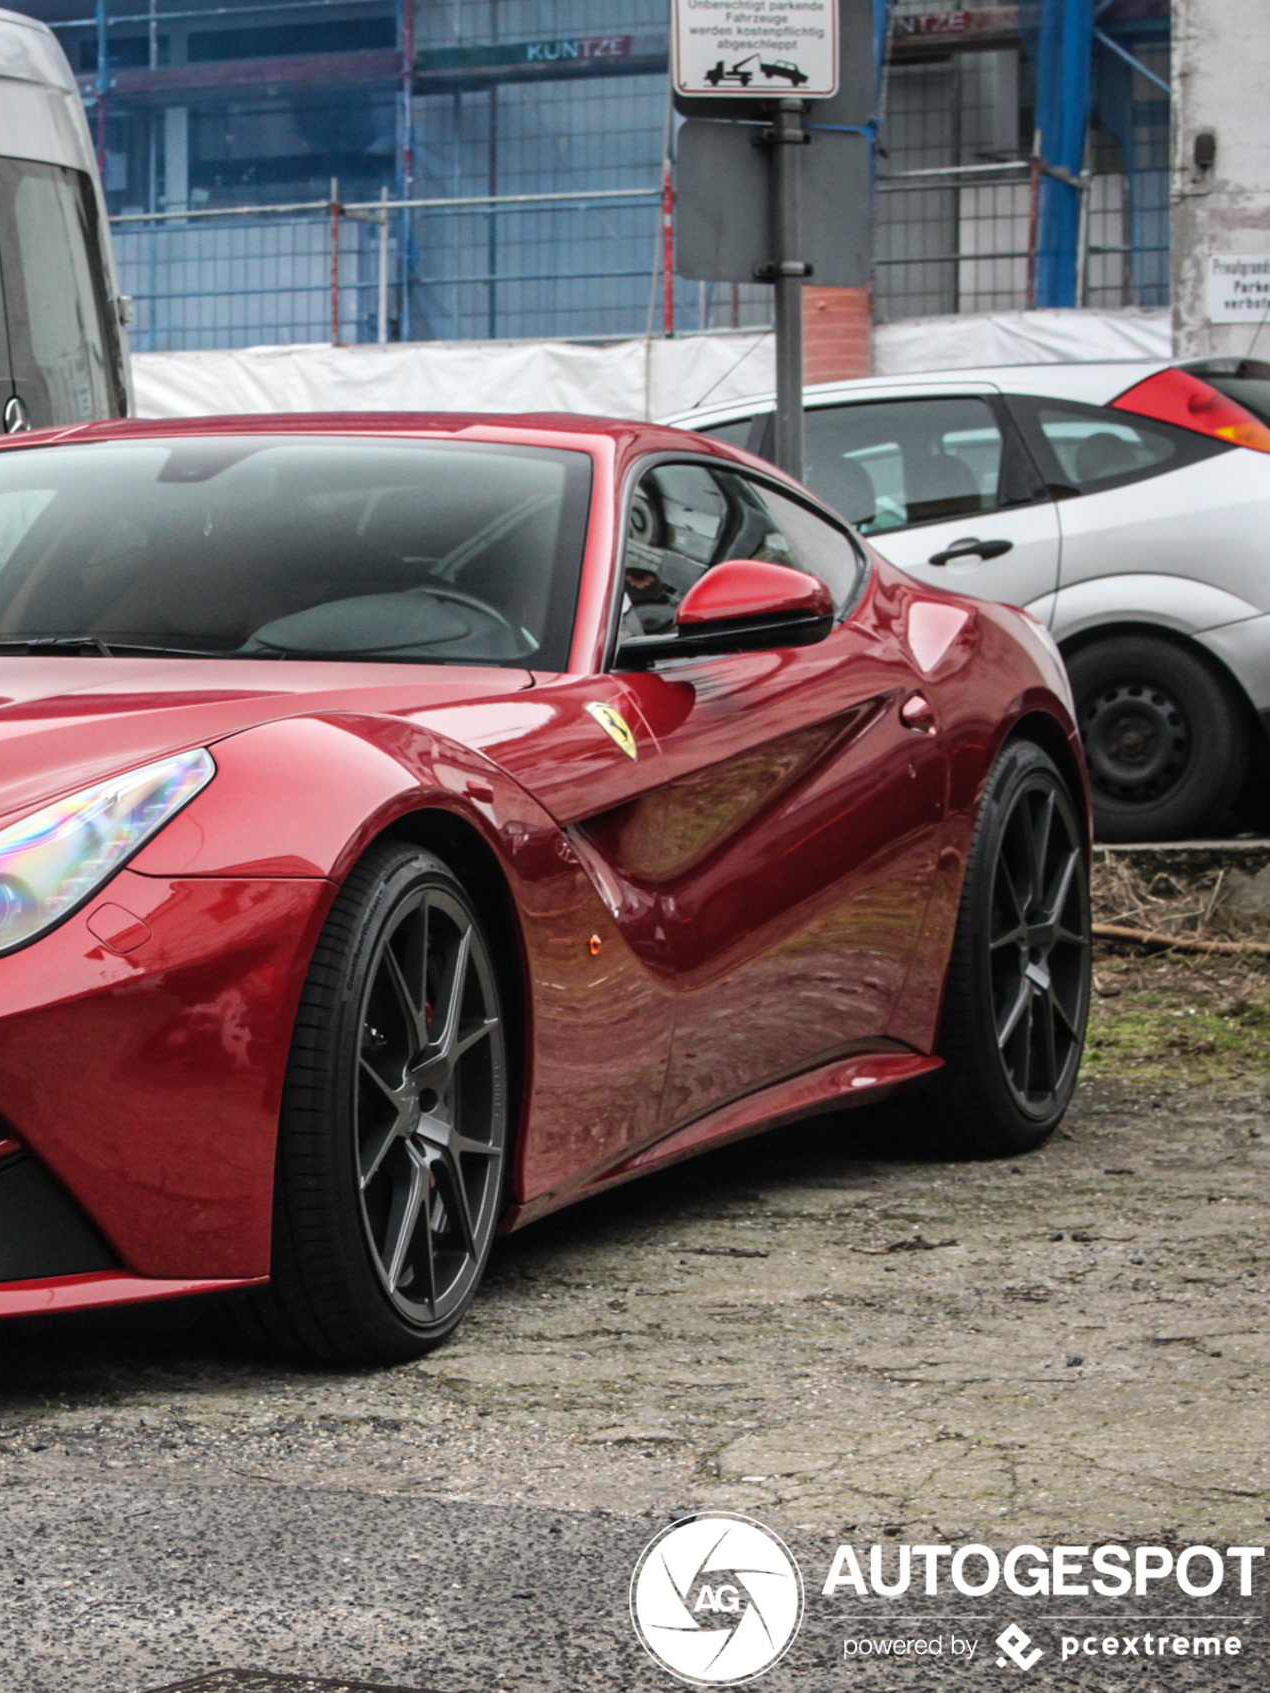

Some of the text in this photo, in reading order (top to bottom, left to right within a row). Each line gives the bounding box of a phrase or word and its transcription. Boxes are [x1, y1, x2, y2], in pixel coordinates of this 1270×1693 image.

[770, 0, 824, 11] parkende
[726, 12, 788, 25] Fahrzeuge
[690, 26, 824, 39] werden kostenpflichtig
[527, 37, 627, 61] KUNTZE
[717, 39, 797, 51] abgeschleppt
